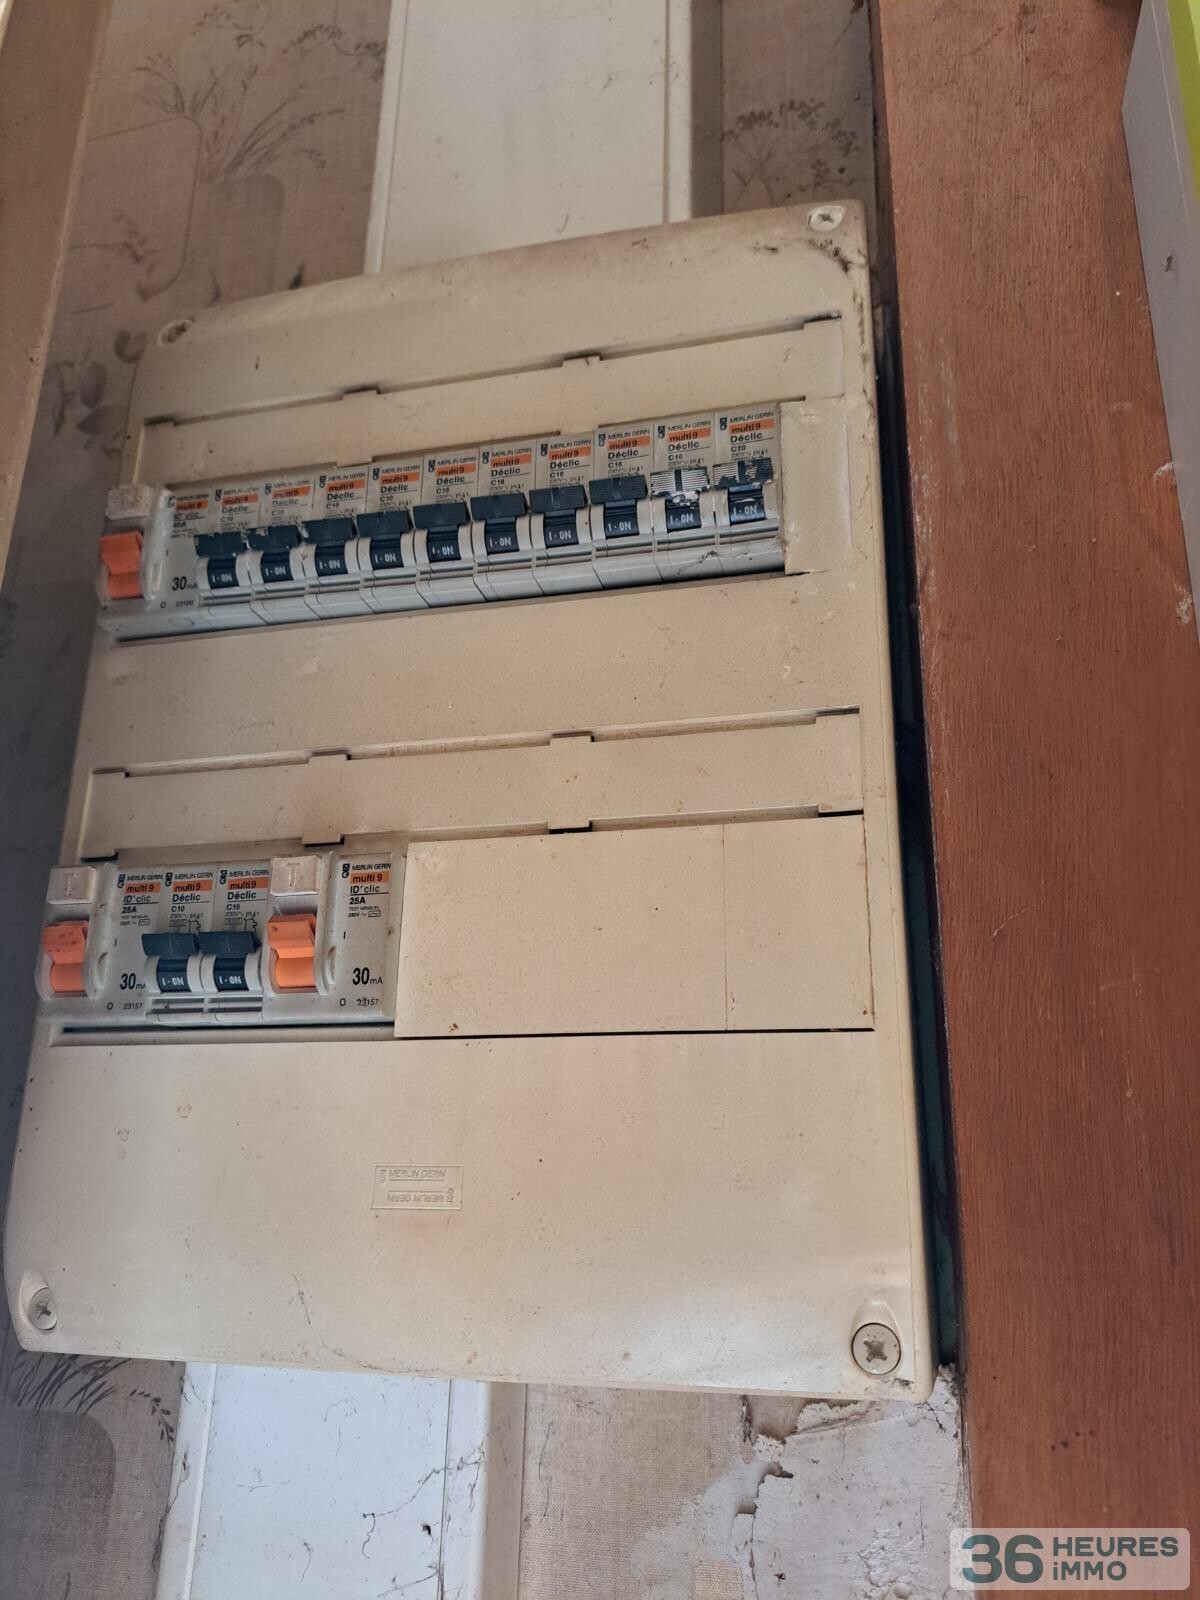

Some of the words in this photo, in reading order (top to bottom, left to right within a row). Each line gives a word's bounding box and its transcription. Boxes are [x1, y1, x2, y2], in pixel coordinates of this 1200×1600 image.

[729, 414, 754, 424] MERLIN
[754, 411, 774, 420] GERIN
[730, 432, 763, 443] Déclic
[667, 441, 700, 451] Déclic
[607, 449, 639, 459] Déclic
[549, 459, 580, 469] Déclic
[491, 467, 521, 477] Déclic
[436, 476, 465, 486] Déclic
[171, 576, 187, 591] 30
[373, 862, 392, 870] GERIN
[172, 893, 201, 902] Déclic
[227, 891, 257, 900] Déclic
[349, 896, 366, 905] 25A
[122, 906, 138, 914] 25A
[119, 972, 137, 990] 30
[352, 966, 370, 986] 30
[369, 976, 383, 985] mA
